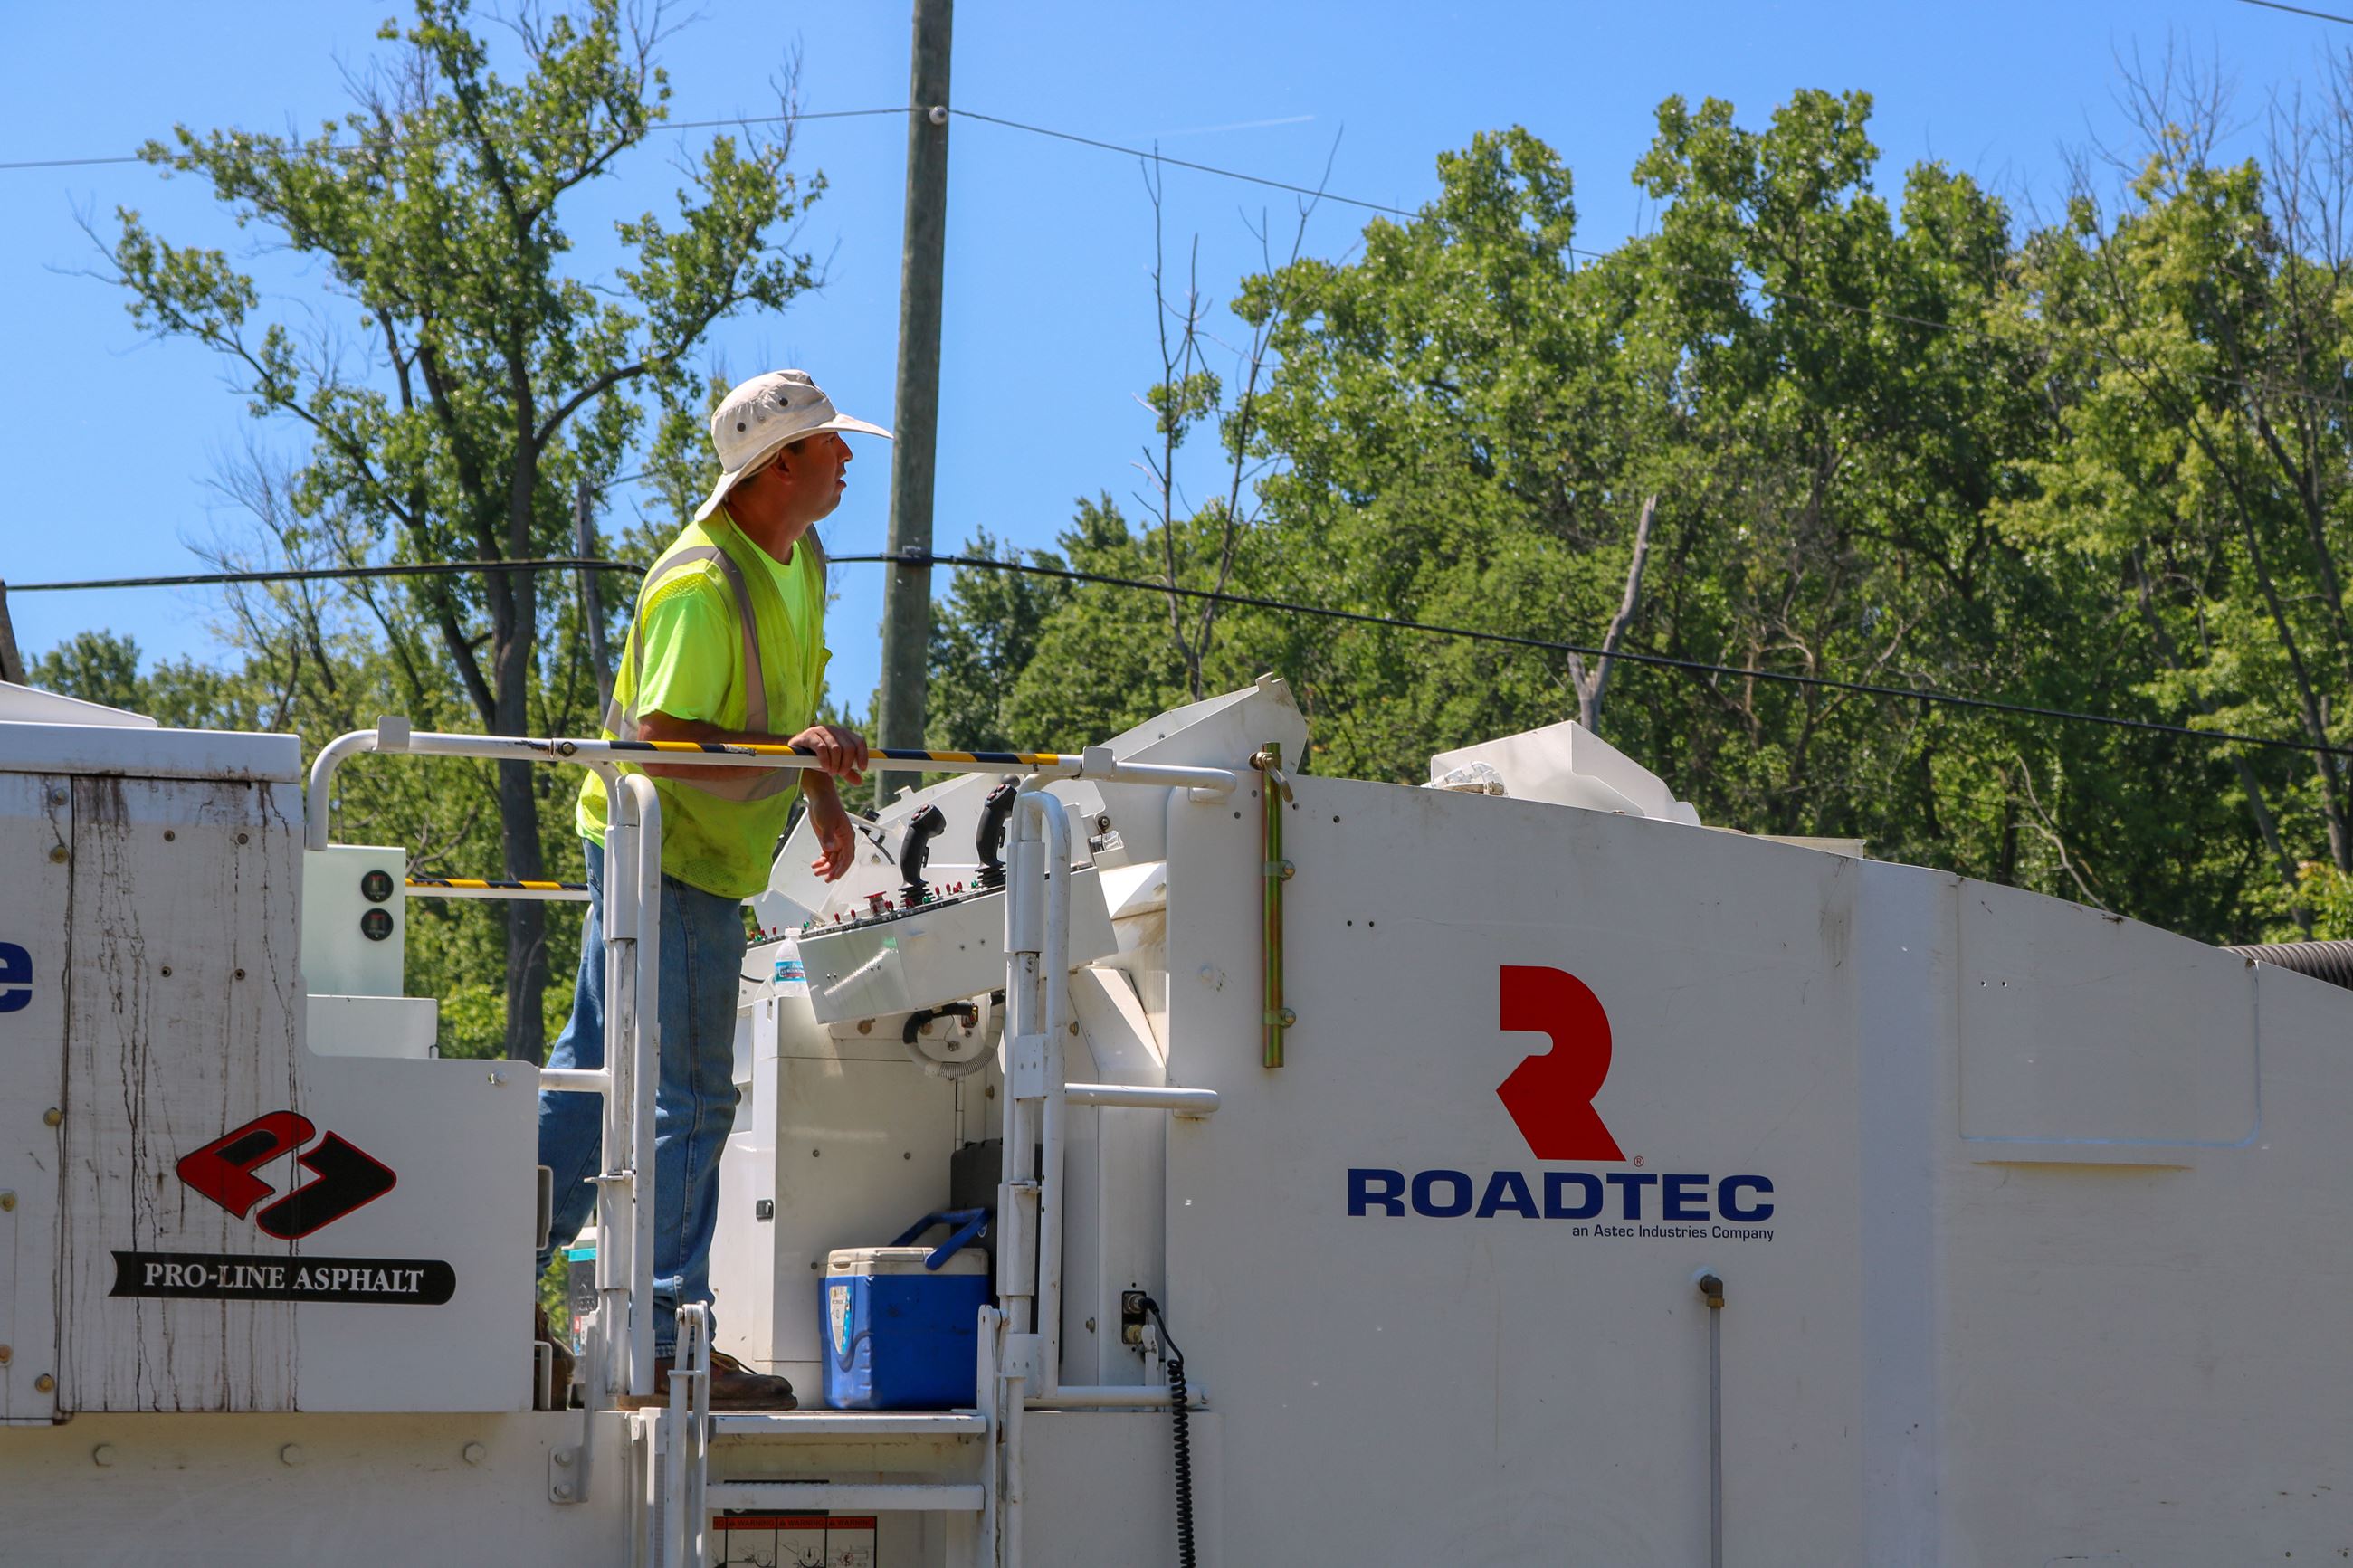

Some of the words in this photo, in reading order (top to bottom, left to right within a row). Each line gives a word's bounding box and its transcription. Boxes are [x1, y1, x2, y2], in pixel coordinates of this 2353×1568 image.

[1347, 1168, 1775, 1221] ROADTEC
[1572, 1227, 1589, 1237] an
[1594, 1224, 1634, 1238] Astec
[1639, 1225, 1708, 1239] Industries
[1712, 1226, 1774, 1242] Company
[144, 1262, 286, 1289] PRO-LINE
[292, 1266, 424, 1293] ASPHALT
[738, 1519, 775, 1527] WARNING
[788, 1519, 824, 1527] WARNING
[837, 1519, 873, 1527] WARNING
